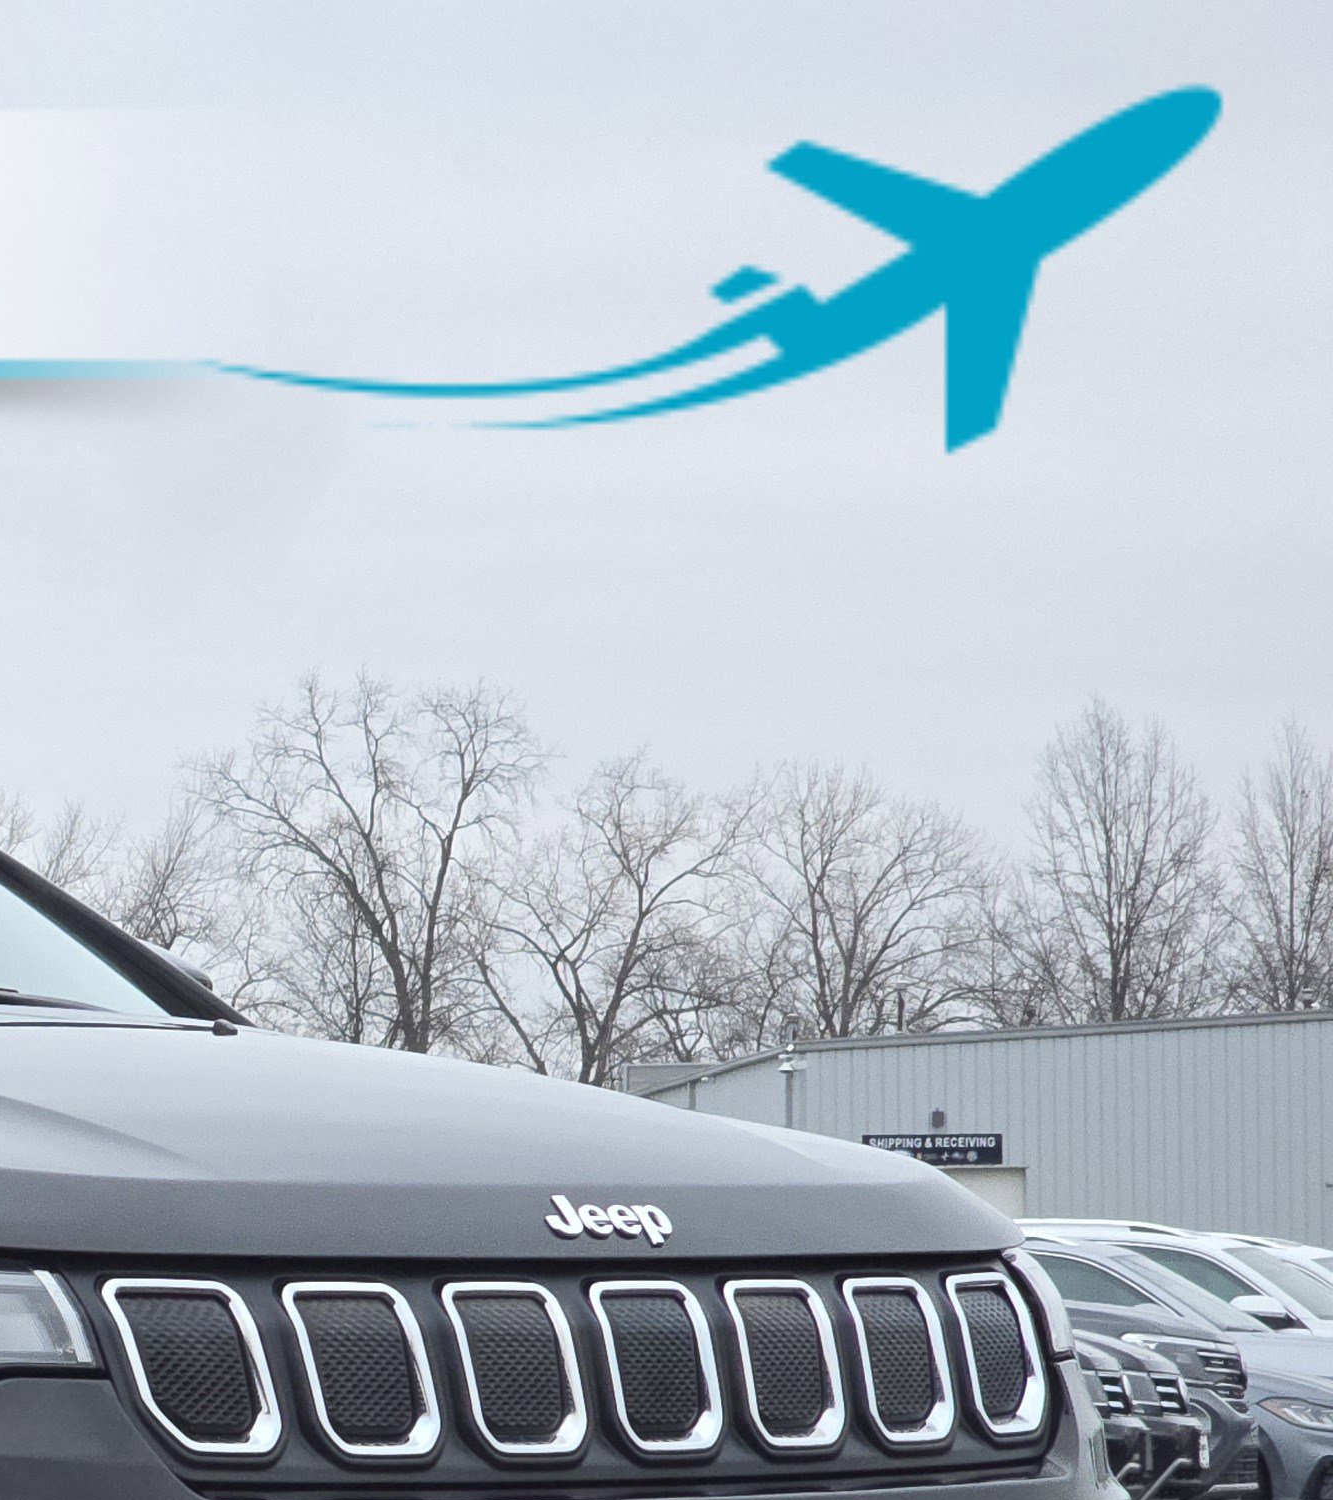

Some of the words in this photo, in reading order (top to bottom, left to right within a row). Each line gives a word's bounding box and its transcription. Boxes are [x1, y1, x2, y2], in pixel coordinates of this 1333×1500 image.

[869, 1137, 923, 1149] SHIPPING
[924, 1137, 933, 1149] &
[935, 1136, 997, 1148] RECEIVING
[545, 1194, 673, 1246] Jeep
